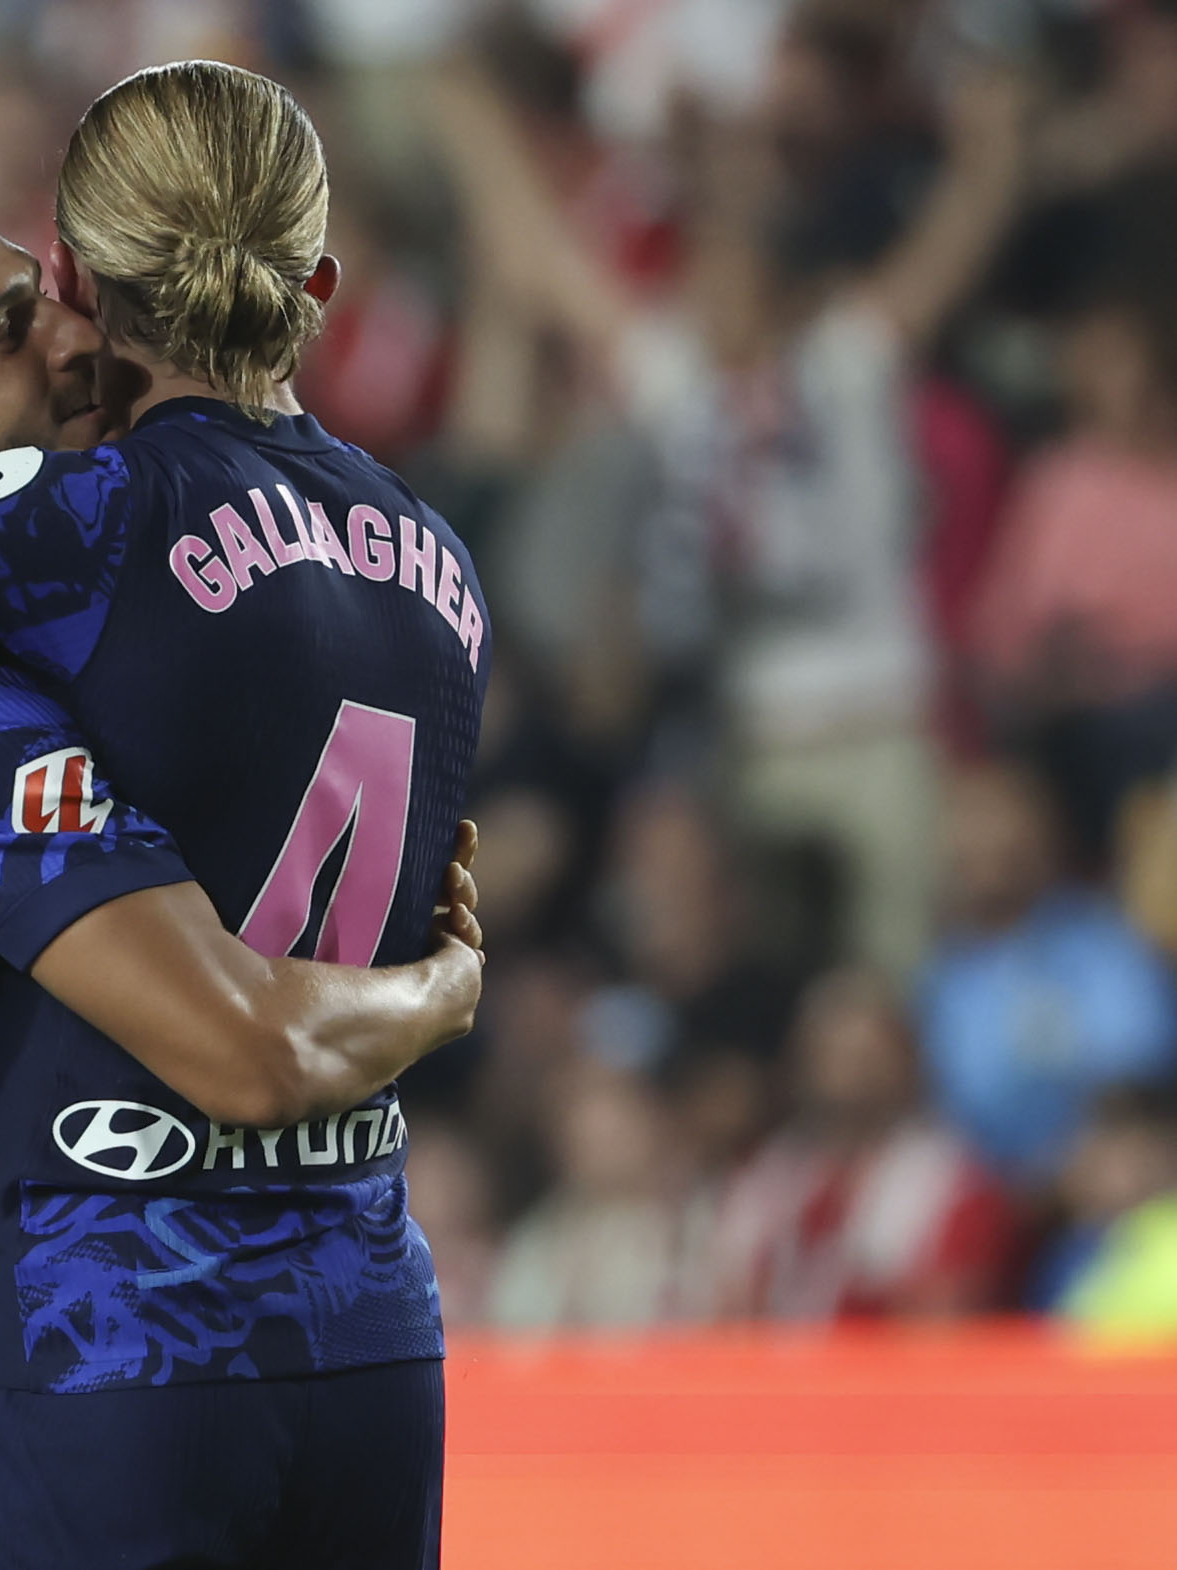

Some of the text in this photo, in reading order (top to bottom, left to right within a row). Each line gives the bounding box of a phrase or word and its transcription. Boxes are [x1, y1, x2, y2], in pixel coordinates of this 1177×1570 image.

[169, 484, 486, 674] GALLAGHER
[235, 698, 416, 969] 4
[202, 1099, 408, 1170] HYUND
